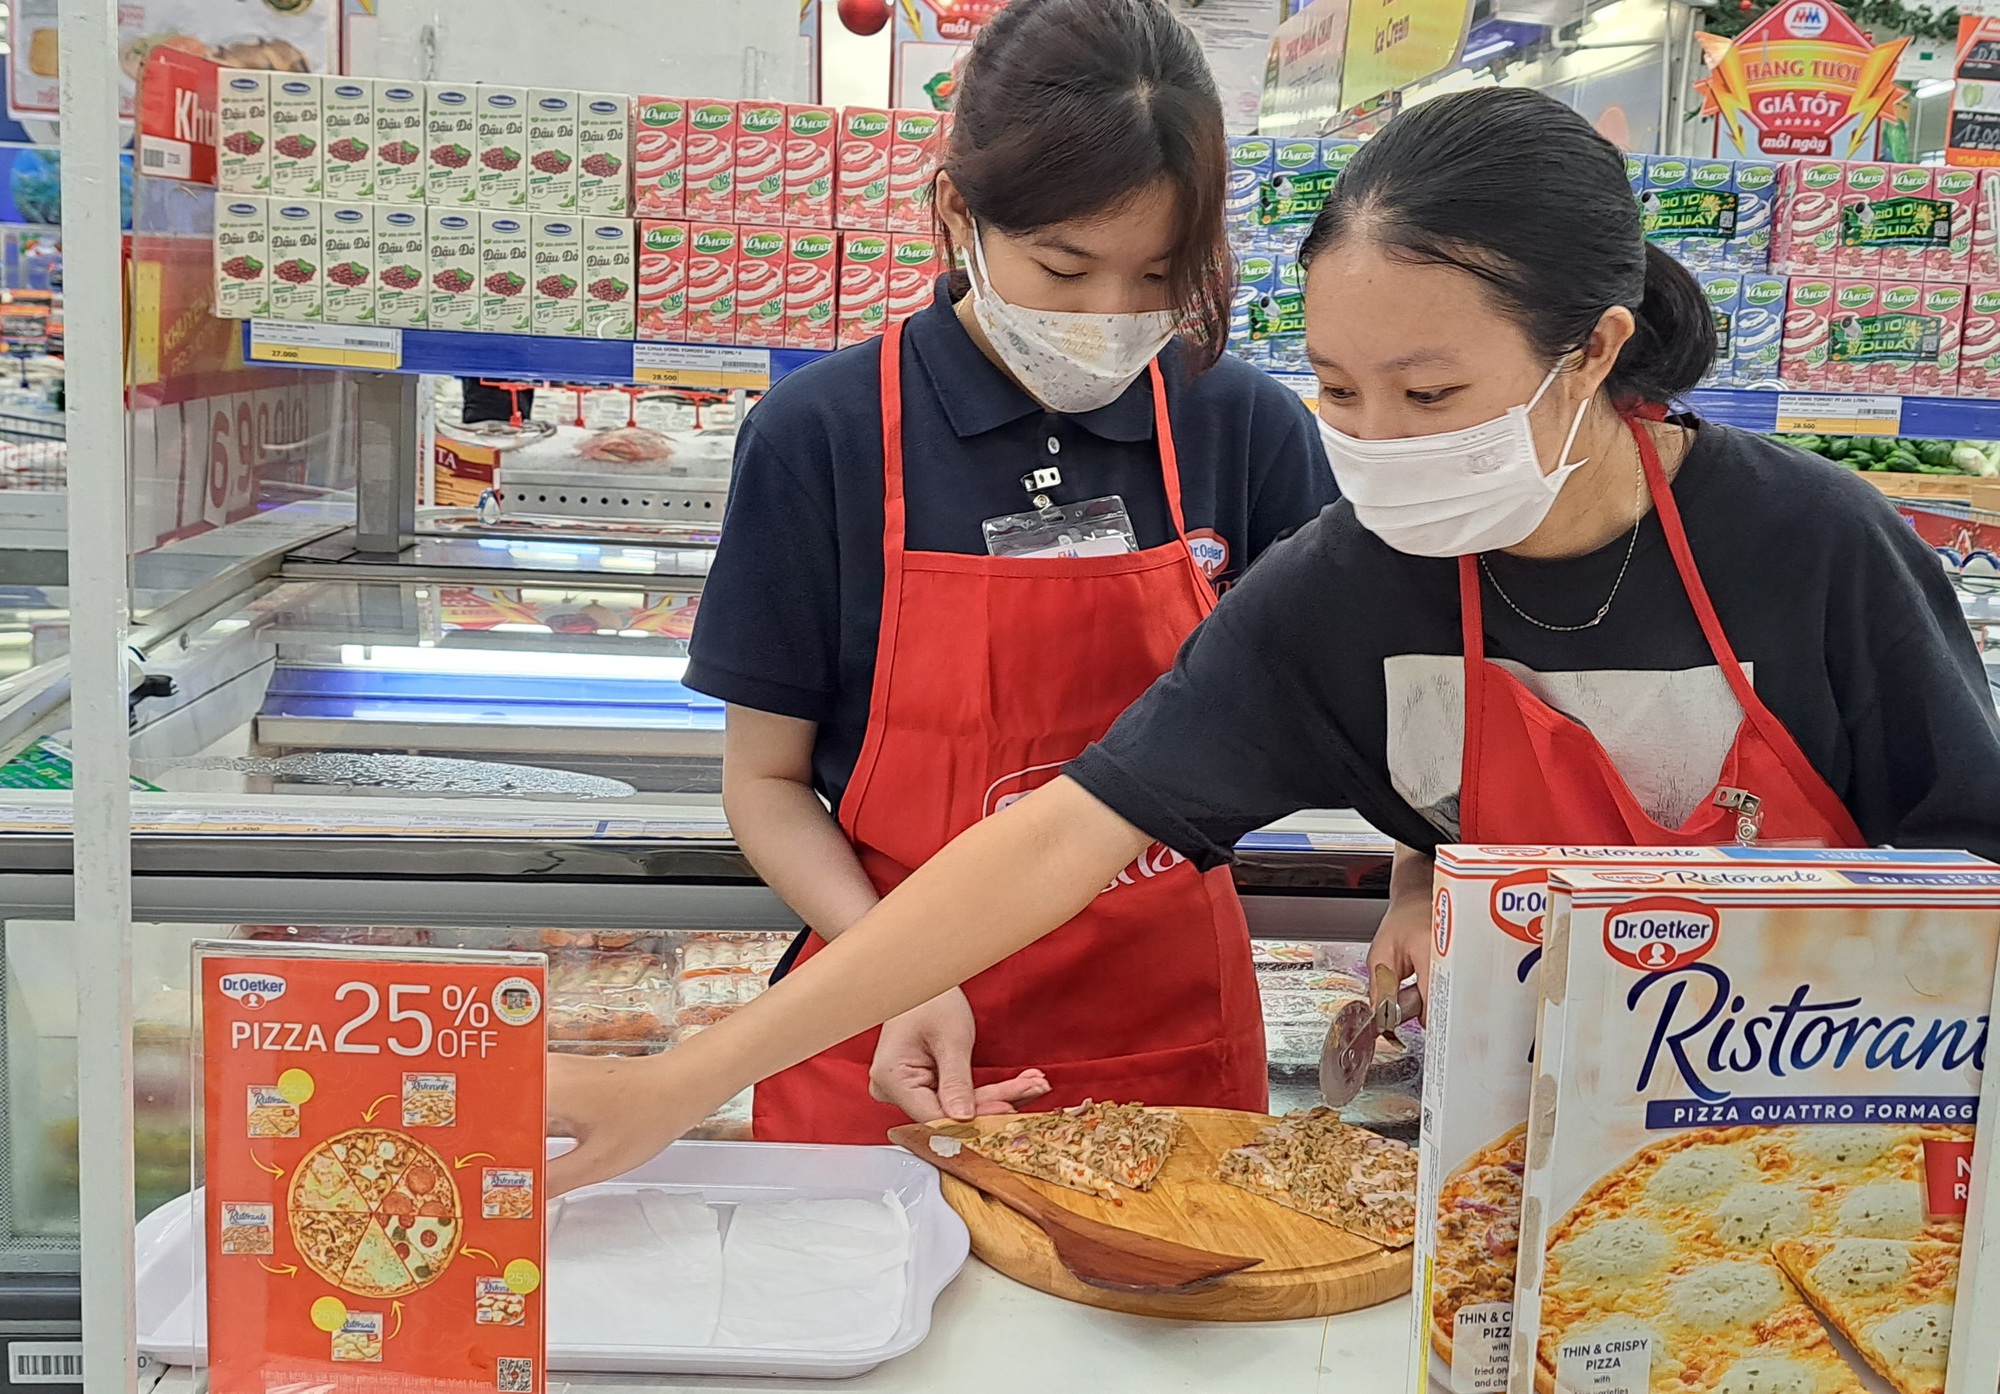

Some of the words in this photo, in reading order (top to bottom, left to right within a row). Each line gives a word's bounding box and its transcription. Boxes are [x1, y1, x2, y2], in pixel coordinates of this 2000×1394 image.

[1758, 91, 1797, 115] GIÁ
[1799, 91, 1843, 117] TỐT
[354, 112, 370, 125] Đỏ
[404, 114, 420, 128] Đỏ
[456, 118, 472, 131] Đỏ
[506, 121, 522, 134] Đỏ
[557, 124, 573, 137] Đỏ
[607, 126, 624, 140] Đỏ
[1762, 132, 1790, 149] mỗi
[1791, 136, 1828, 153] ngày
[300, 232, 316, 246] Đỏ
[354, 236, 370, 249] Đỏ
[406, 238, 422, 252] Đỏ
[459, 242, 476, 255] Đỏ
[510, 246, 526, 259] Đỏ
[562, 248, 578, 262] Đỏ
[614, 252, 630, 265] Đỏ
[1705, 286, 1738, 296] OMOST
[1972, 298, 2000, 311] YOMO
[1546, 846, 1700, 859] Ristorante
[1661, 870, 1822, 886] Ristorante
[1614, 920, 1710, 940] Dr.Oetker
[223, 978, 284, 994] Dr.Oetker
[232, 1021, 328, 1052] PIZZA
[437, 1028, 498, 1058] OFF
[1674, 1105, 1740, 1123] PIZZA
[1750, 1104, 1854, 1121] QUATTRO
[1865, 1104, 1973, 1120] FORMAGG
[508, 1272, 537, 1285] 25%
[1458, 1312, 1486, 1325] THIN
[1490, 1311, 1498, 1323] &
[1482, 1327, 1510, 1339] PIZZ
[1492, 1342, 1509, 1352] with
[1562, 1344, 1591, 1359] THIN
[1593, 1344, 1602, 1355] &
[1605, 1338, 1648, 1354] CRISPY
[1586, 1357, 1621, 1371] PIZZA
[1474, 1366, 1494, 1376] fried
[1474, 1378, 1491, 1388] and
[1594, 1375, 1610, 1384] with
